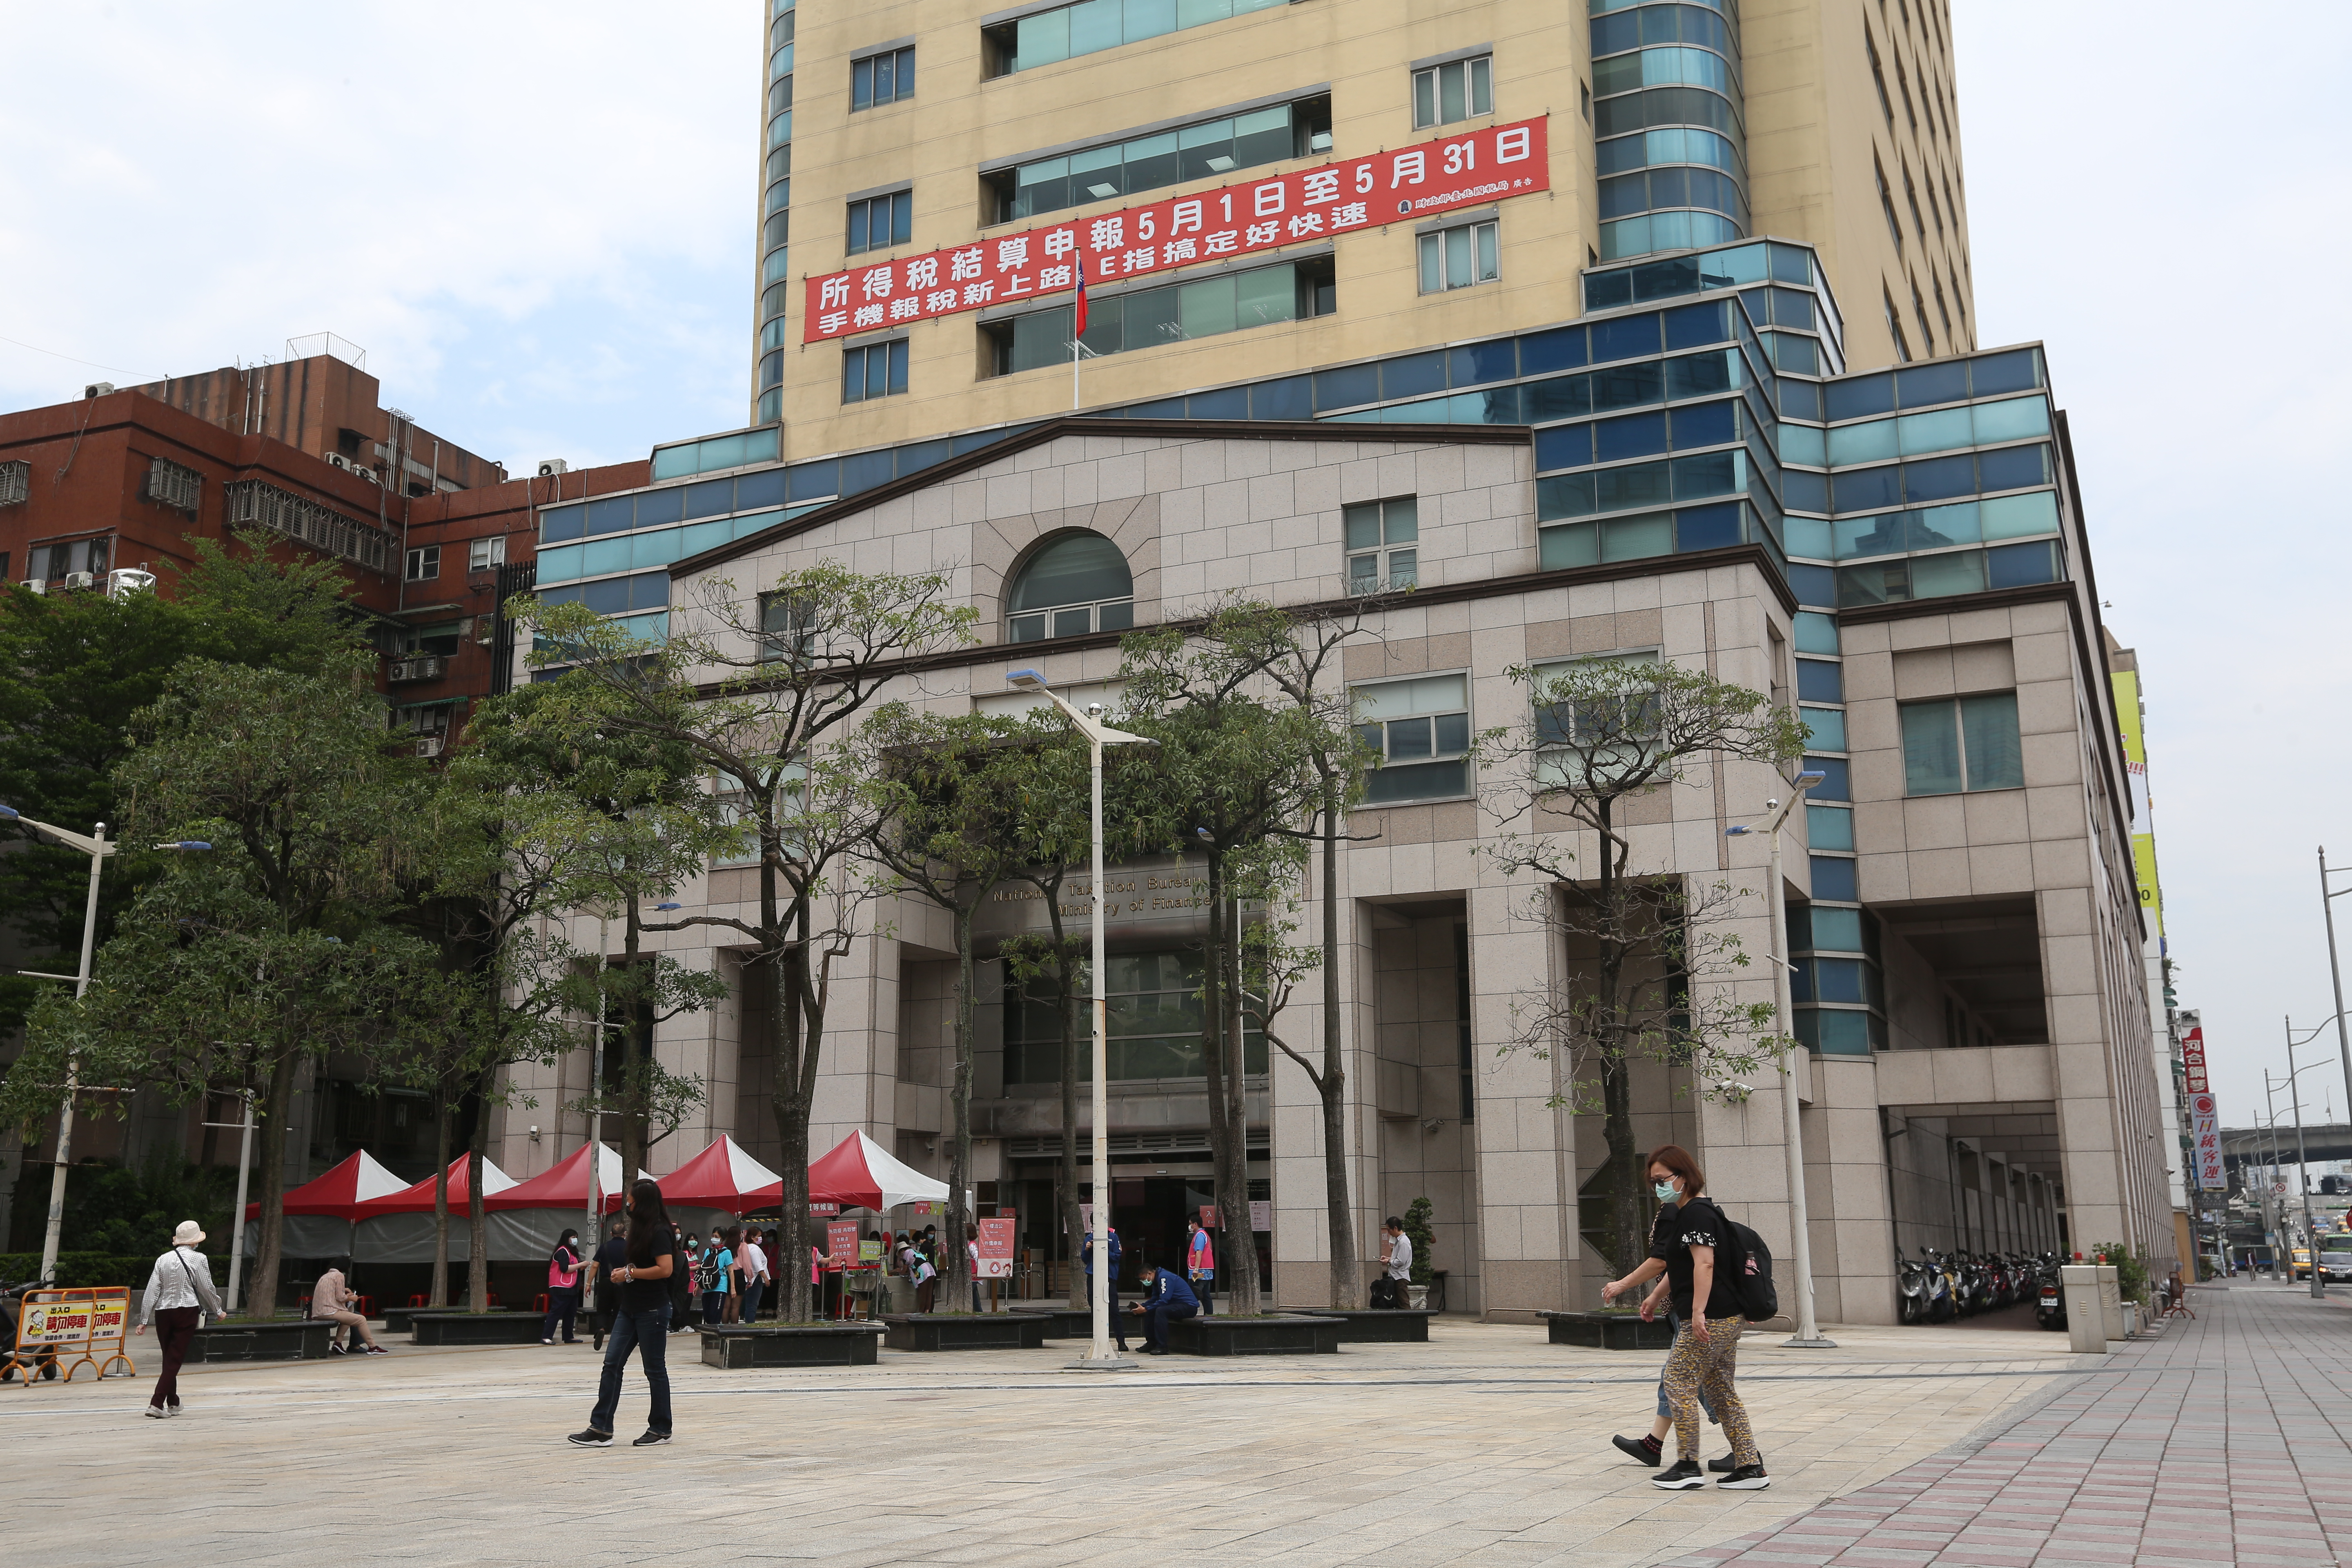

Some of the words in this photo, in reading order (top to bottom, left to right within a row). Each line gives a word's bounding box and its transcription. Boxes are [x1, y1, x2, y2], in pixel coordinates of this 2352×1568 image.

[1513, 177, 1532, 188] 廣告
[1100, 201, 1368, 276] E指搞定好快速
[993, 889, 1047, 902] Nation
[1068, 880, 1135, 896] Taxtion
[1058, 903, 1120, 916] Minisry
[1130, 898, 1144, 911] of
[1152, 896, 1211, 910] Finance
[2185, 1040, 2207, 1092] 河合鋼琴
[50, 1306, 70, 1314] 出入口
[46, 1314, 88, 1333] 請勿停車
